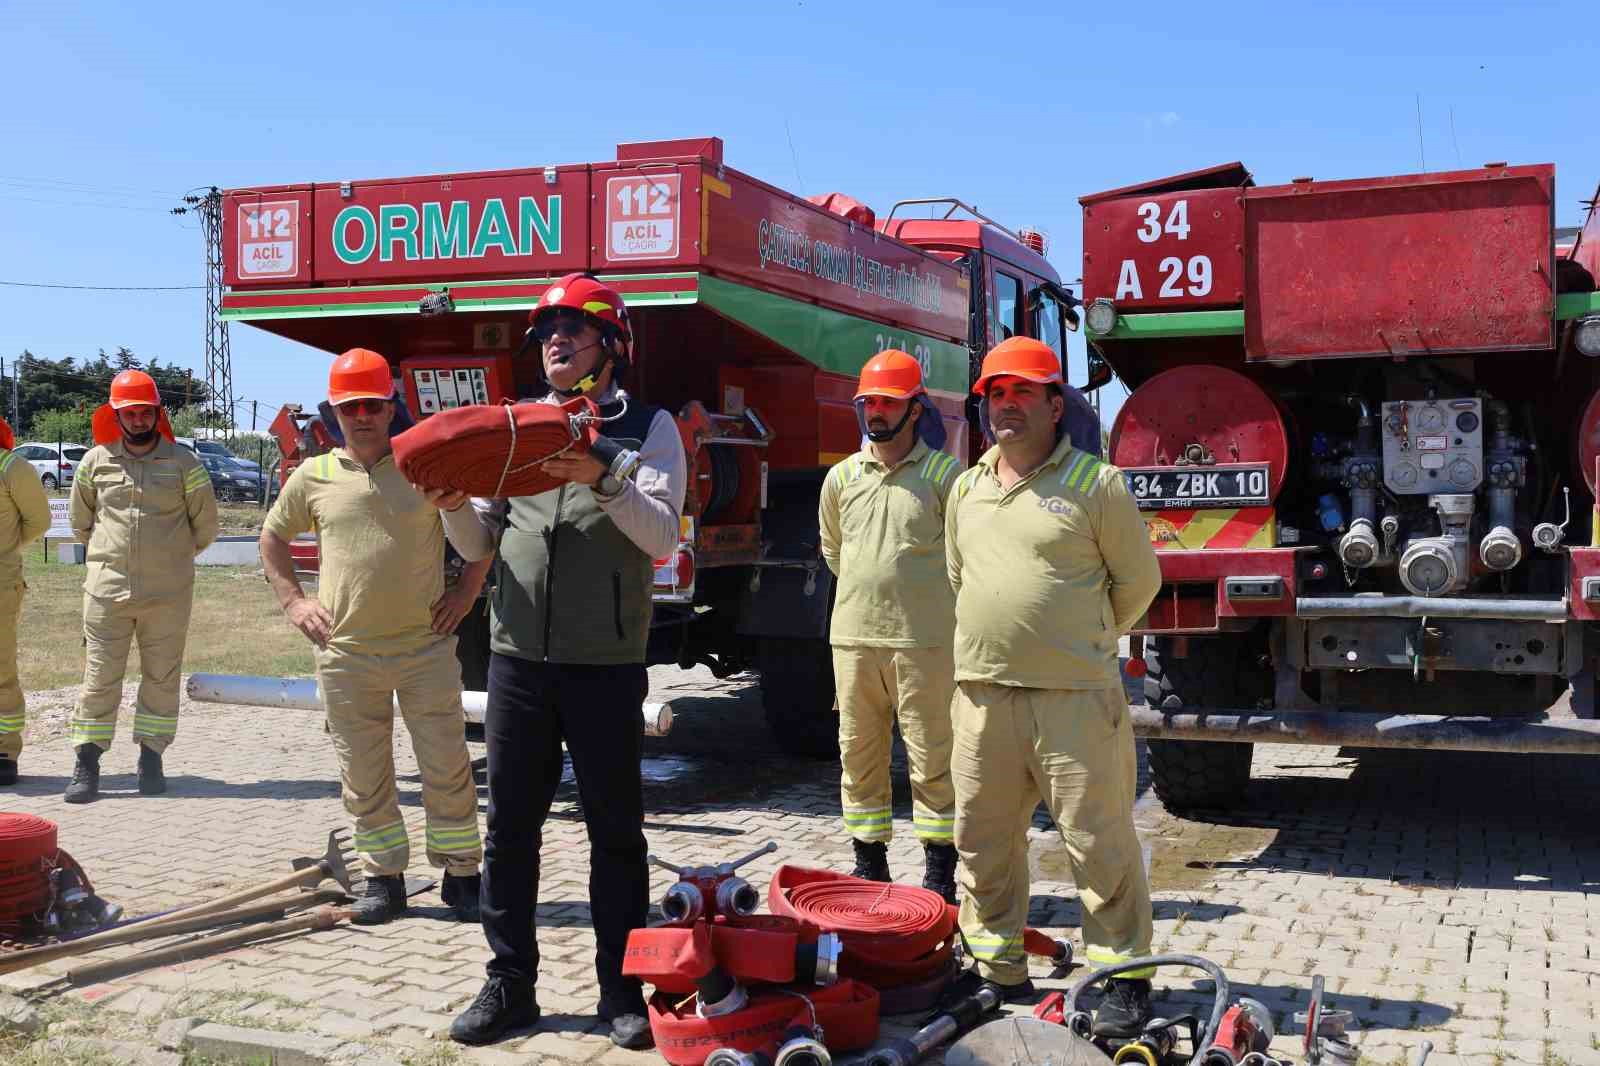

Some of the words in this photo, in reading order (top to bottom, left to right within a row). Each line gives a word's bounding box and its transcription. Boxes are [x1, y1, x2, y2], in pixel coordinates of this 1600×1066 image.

[616, 183, 672, 216] 112
[246, 208, 291, 239] 112
[332, 194, 562, 264] ORMAN
[623, 221, 662, 240] ACİL
[1137, 200, 1191, 243] 34
[758, 218, 812, 271] ÇATALCA
[814, 239, 850, 287] ORMAN
[1115, 259, 1143, 300] A
[1159, 255, 1213, 297] 29
[1134, 475, 1163, 498] 34
[1176, 473, 1220, 497] ZBK
[1235, 471, 1263, 496] 10
